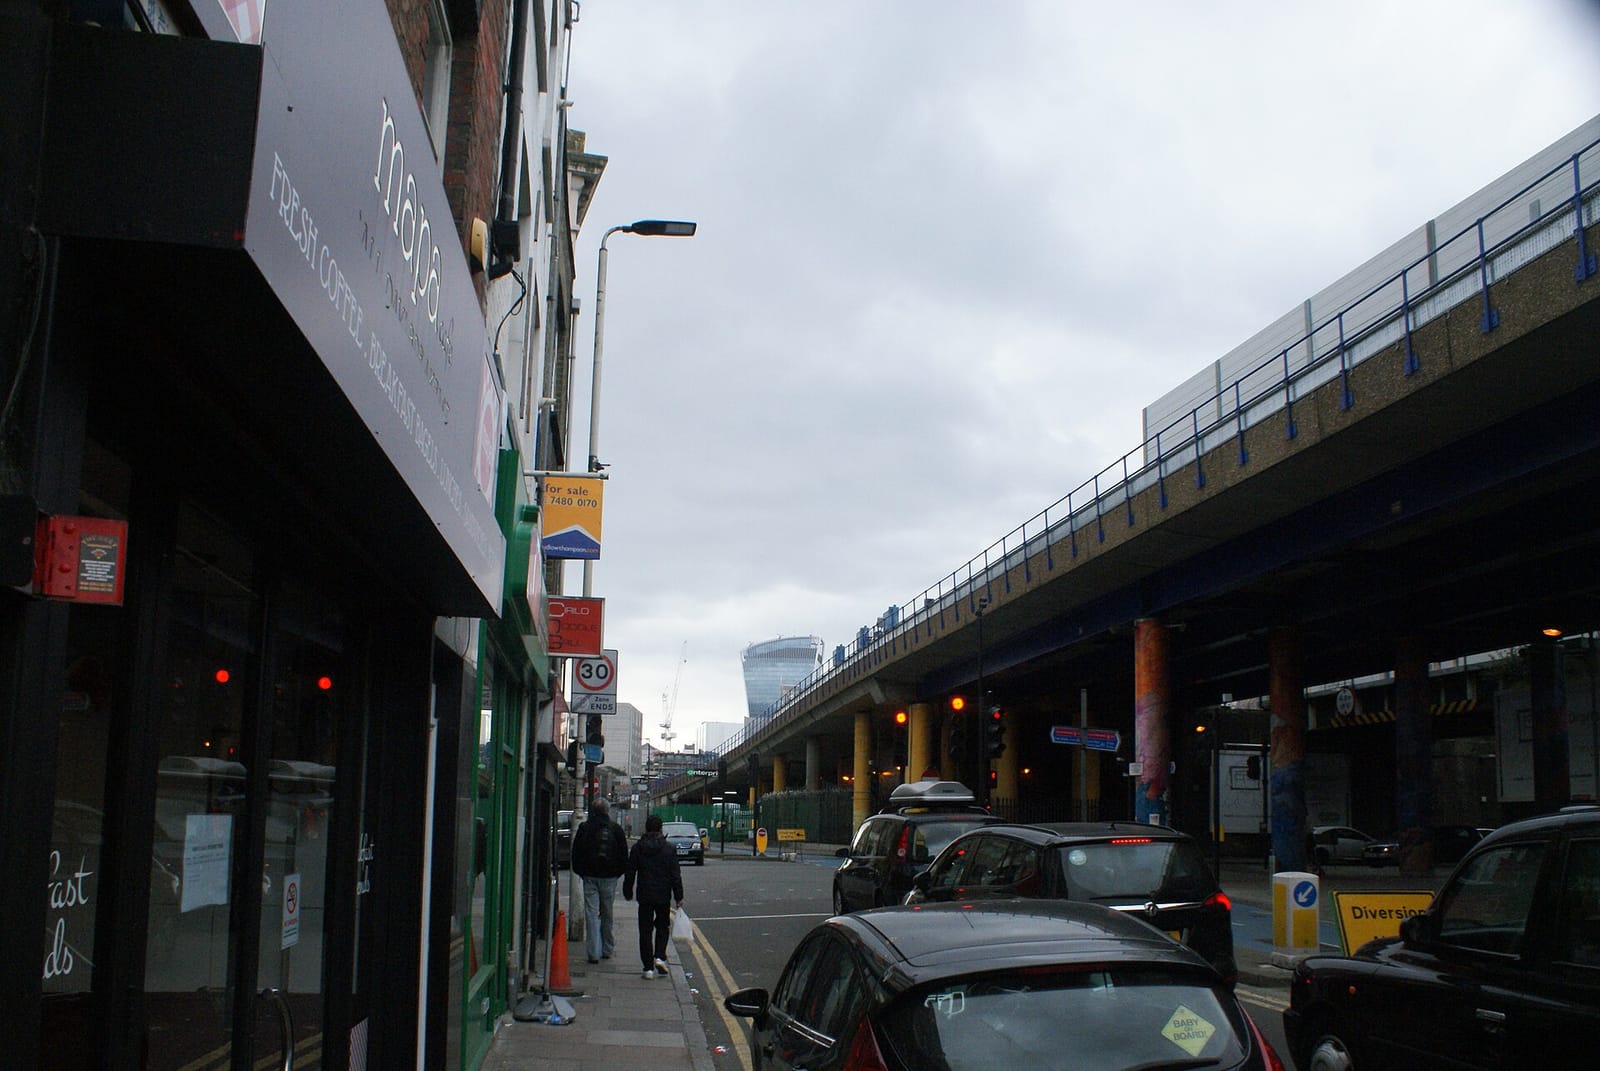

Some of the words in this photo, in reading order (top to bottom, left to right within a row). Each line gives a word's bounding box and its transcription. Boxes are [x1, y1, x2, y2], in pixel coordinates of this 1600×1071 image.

[374, 97, 442, 331] mapa
[270, 152, 318, 269] FRESH
[369, 331, 416, 434] BREAKFAST
[545, 483, 562, 493] for
[567, 486, 589, 496] sale
[550, 496, 573, 506] 7480
[577, 499, 598, 508] 0170
[581, 663, 609, 680] 30
[590, 703, 614, 711] ENDS
[1173, 1018, 1200, 1027] BABY
